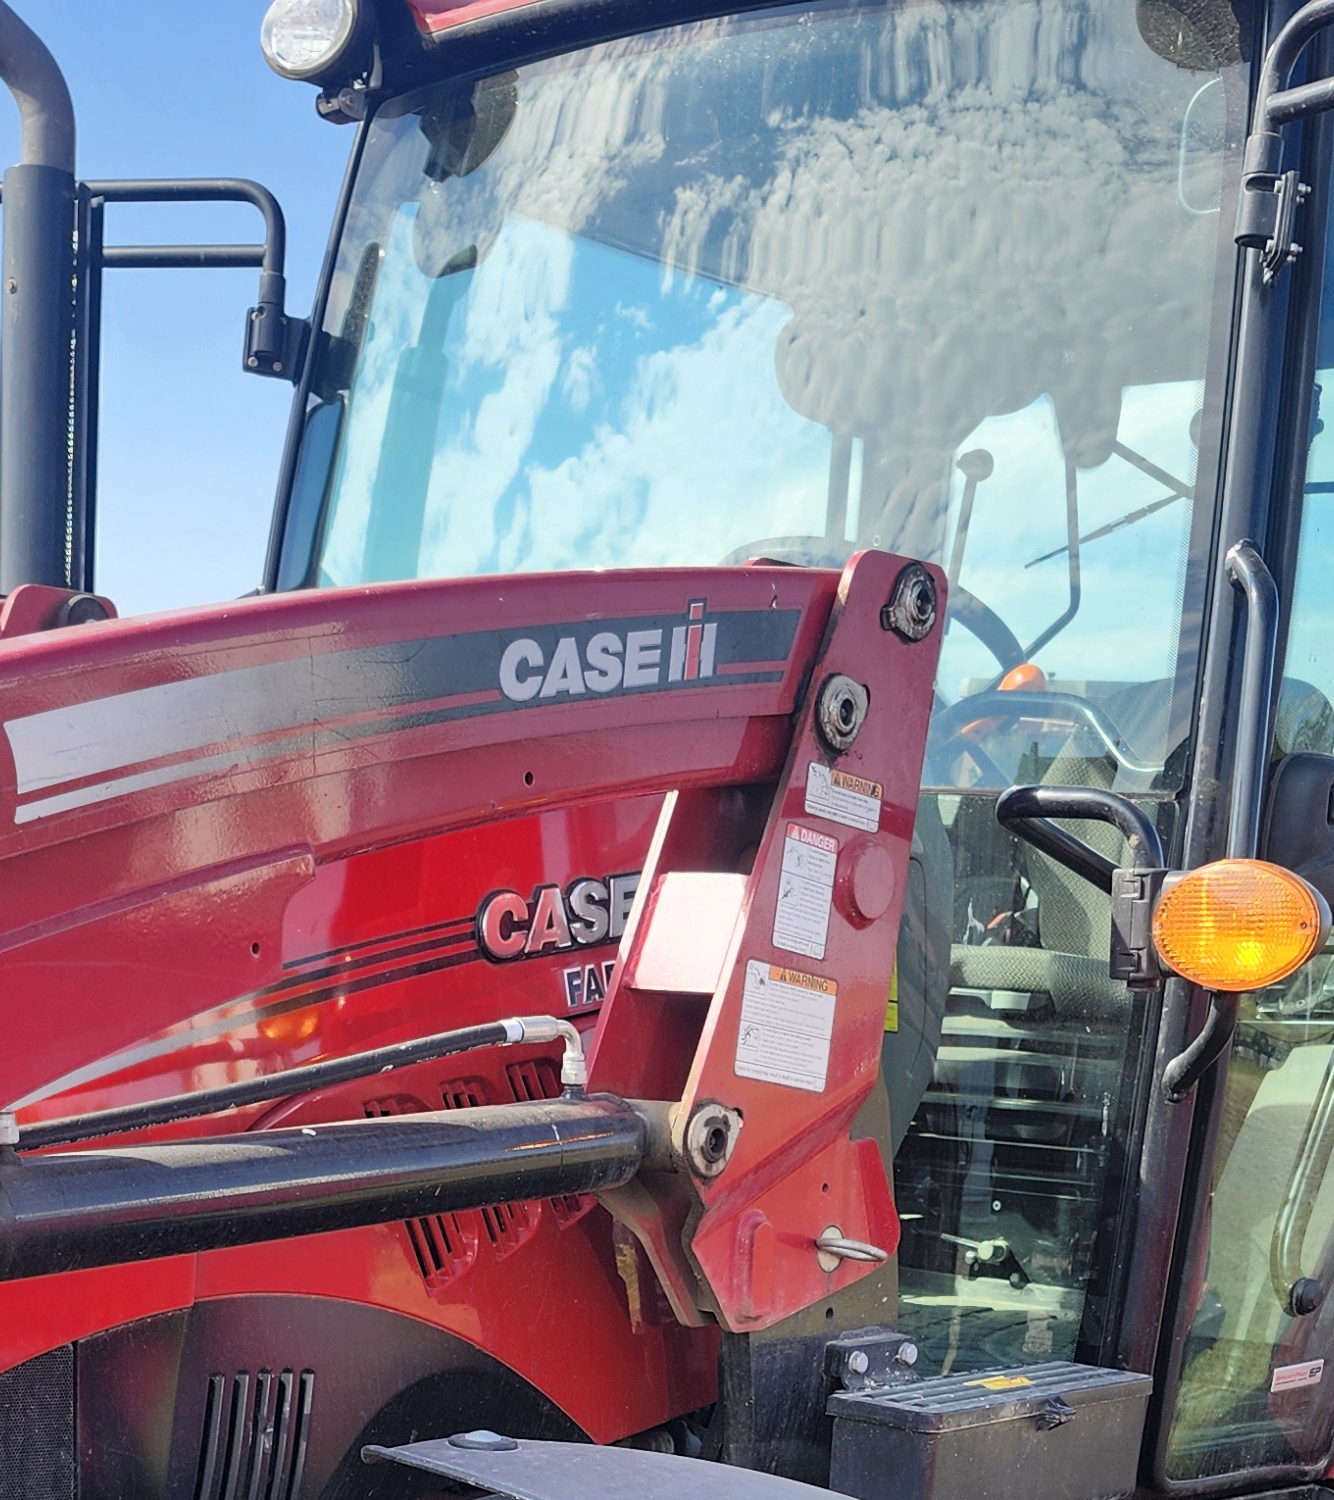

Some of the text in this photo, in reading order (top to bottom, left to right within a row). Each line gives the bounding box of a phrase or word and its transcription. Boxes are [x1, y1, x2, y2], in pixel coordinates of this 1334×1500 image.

[499, 632, 662, 701] CASE
[841, 773, 880, 799] WARNING
[800, 828, 836, 853] DANGER
[788, 968, 829, 992] WARNING
